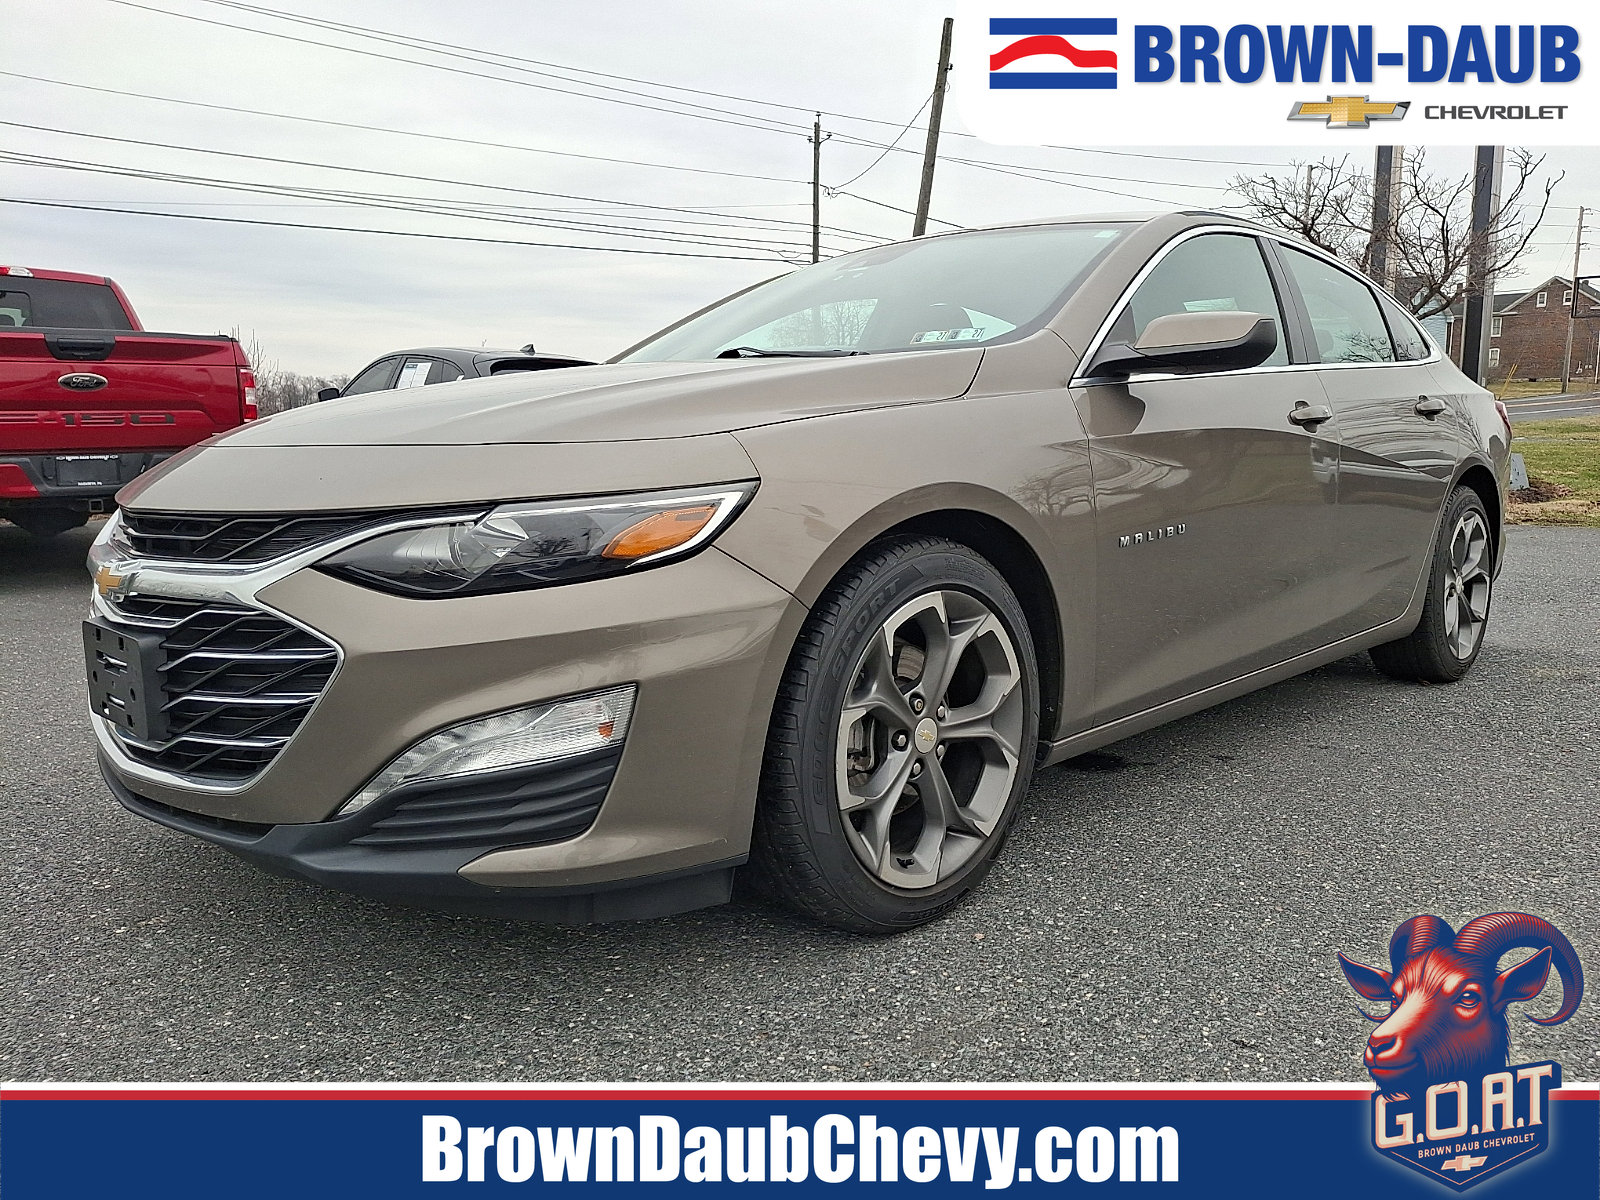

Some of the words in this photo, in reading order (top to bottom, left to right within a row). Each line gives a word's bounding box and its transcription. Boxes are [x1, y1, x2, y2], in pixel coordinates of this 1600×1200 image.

[70, 376, 97, 387] Ford
[1119, 523, 1186, 547] MALIBU
[831, 578, 901, 681] SPORT
